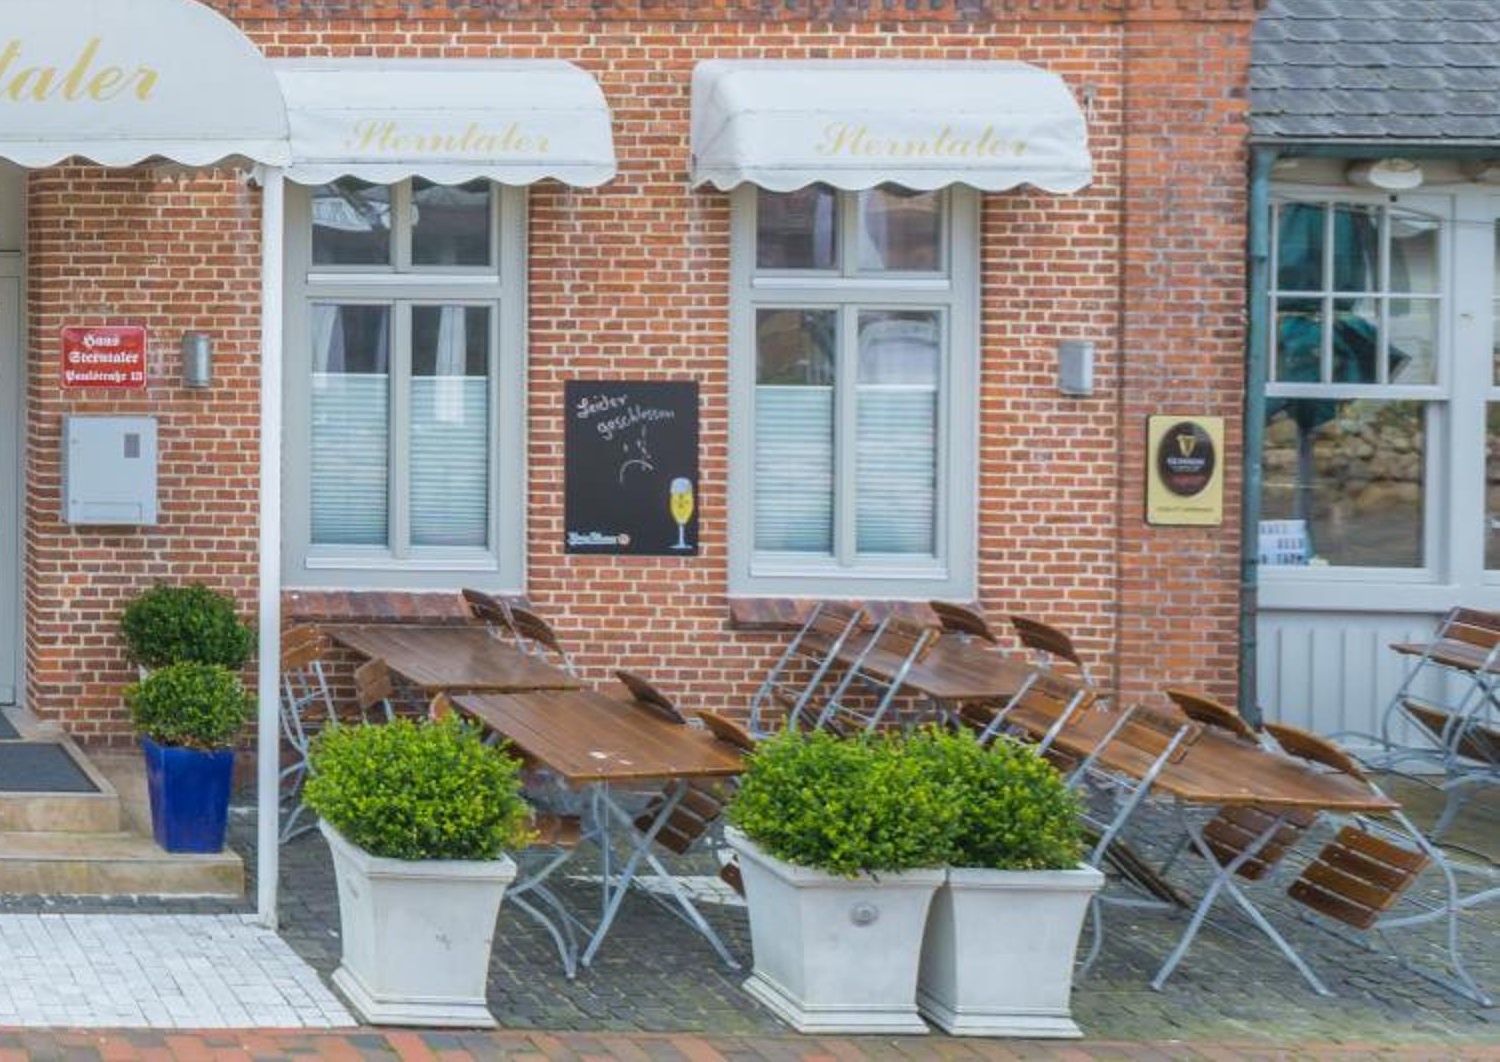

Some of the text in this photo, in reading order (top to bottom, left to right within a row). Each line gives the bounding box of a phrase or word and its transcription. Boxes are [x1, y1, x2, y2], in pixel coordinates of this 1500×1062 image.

[344, 117, 551, 155] Sterntaler
[815, 120, 1029, 157] Sterntaler
[68, 350, 139, 363] Sterntaler
[576, 394, 627, 419] Leider
